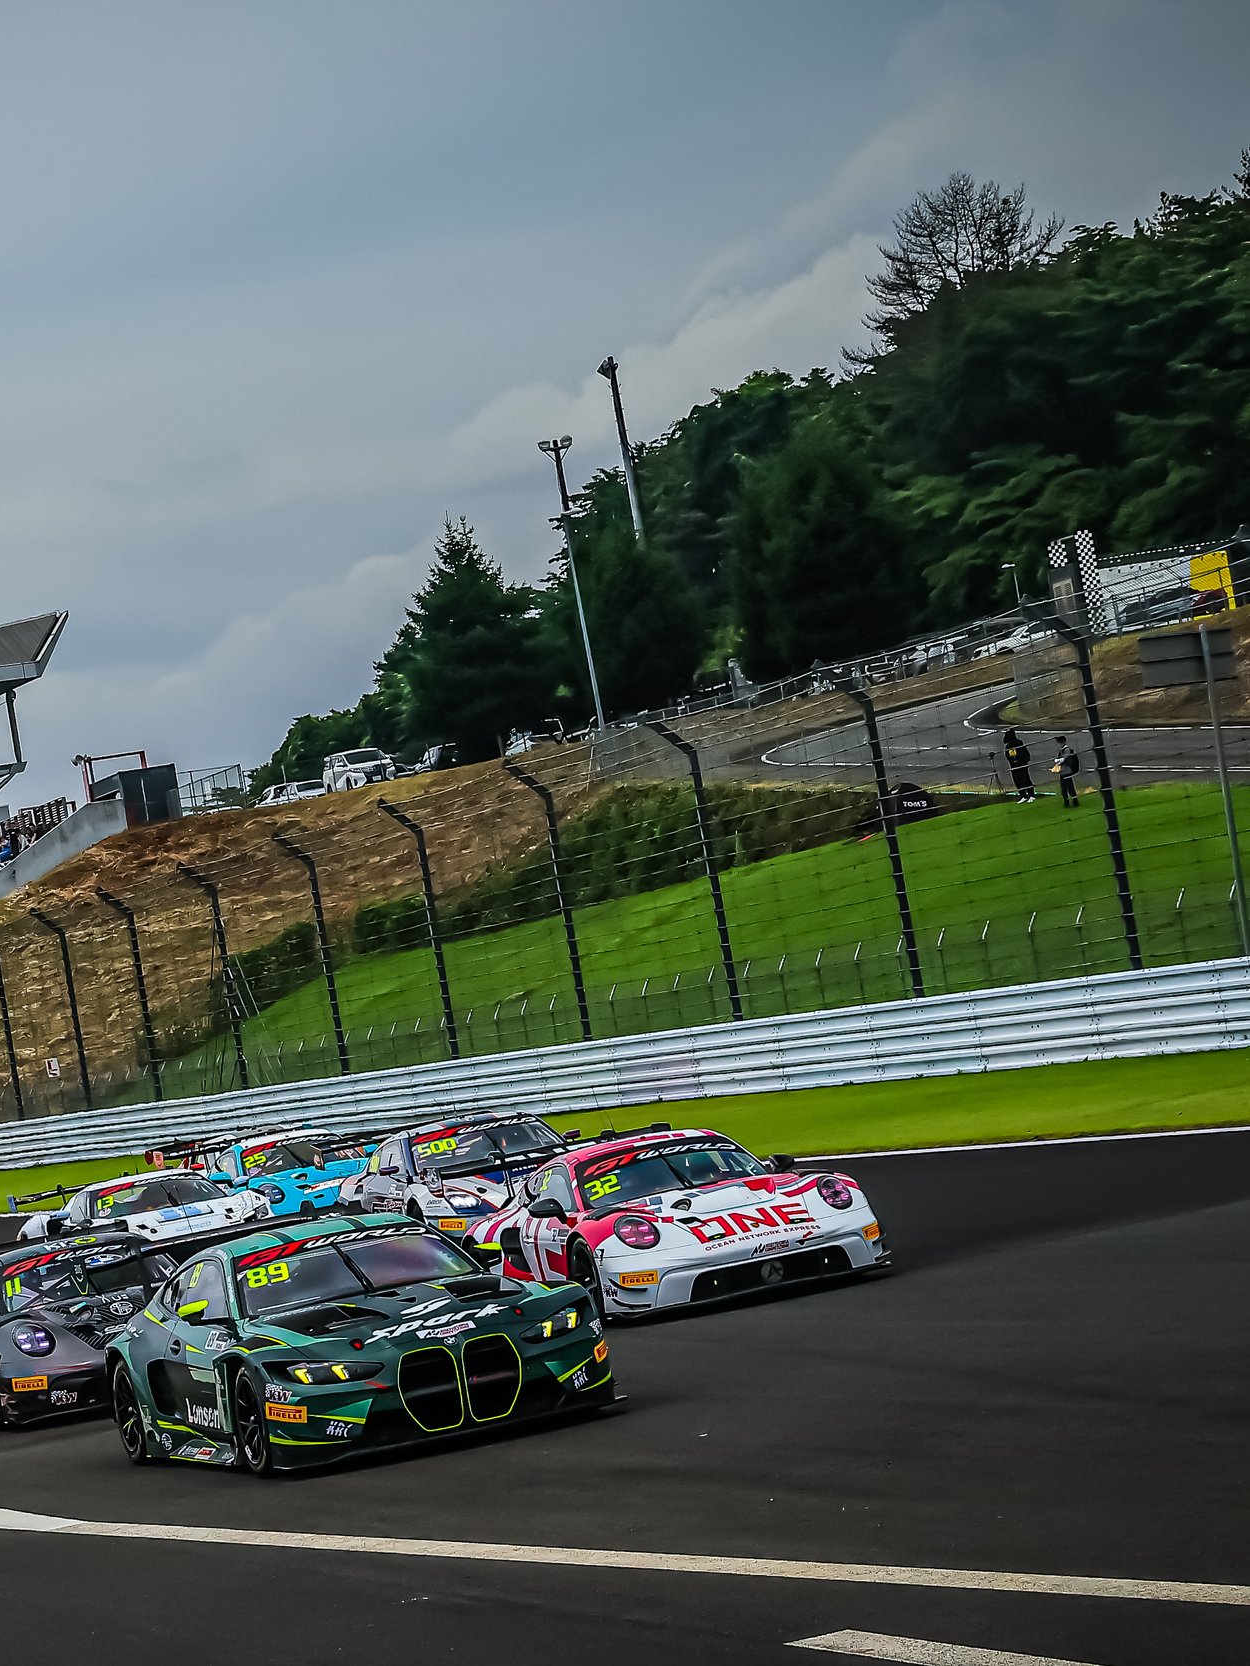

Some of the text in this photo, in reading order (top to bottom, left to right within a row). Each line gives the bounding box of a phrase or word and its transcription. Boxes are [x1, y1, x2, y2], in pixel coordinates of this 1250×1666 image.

[902, 800, 927, 808] TOM'S
[417, 1137, 457, 1159] 500
[636, 1142, 737, 1161] WORLD
[242, 1152, 267, 1169] 25
[584, 1174, 622, 1201] 32
[97, 1195, 115, 1210] 13
[689, 1202, 817, 1244] ONE
[303, 1226, 427, 1250] WORLD
[705, 1239, 736, 1252] OCEAN
[738, 1229, 781, 1242] NETWORK
[784, 1224, 822, 1233] EXPRESS
[246, 1262, 290, 1288] 89
[621, 1273, 655, 1285] PIRELLI
[5, 1277, 21, 1297] 11
[15, 1379, 44, 1390] PIRELLI
[268, 1406, 303, 1420] PIRELLI
